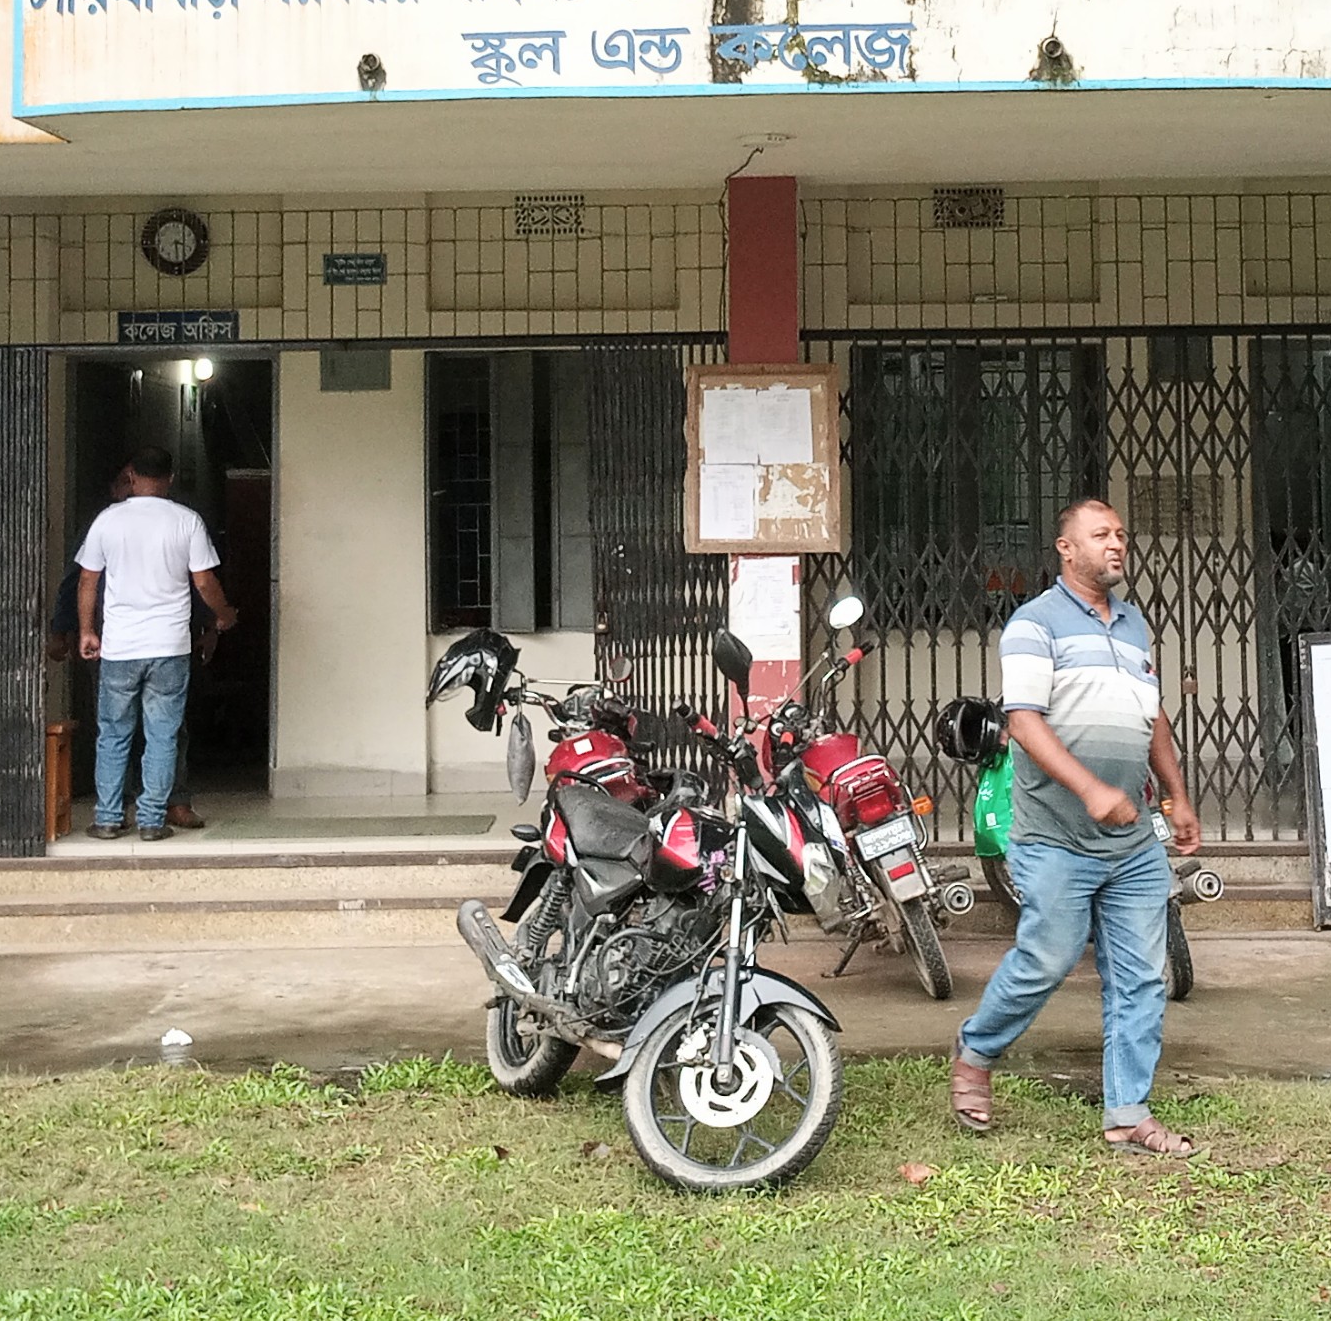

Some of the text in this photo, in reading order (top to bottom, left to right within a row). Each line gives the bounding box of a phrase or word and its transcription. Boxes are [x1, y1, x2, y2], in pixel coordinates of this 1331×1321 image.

[461, 22, 918, 86] স্কুল এন্ড কলেজ
[122, 315, 234, 341] কলেজ অফিস
